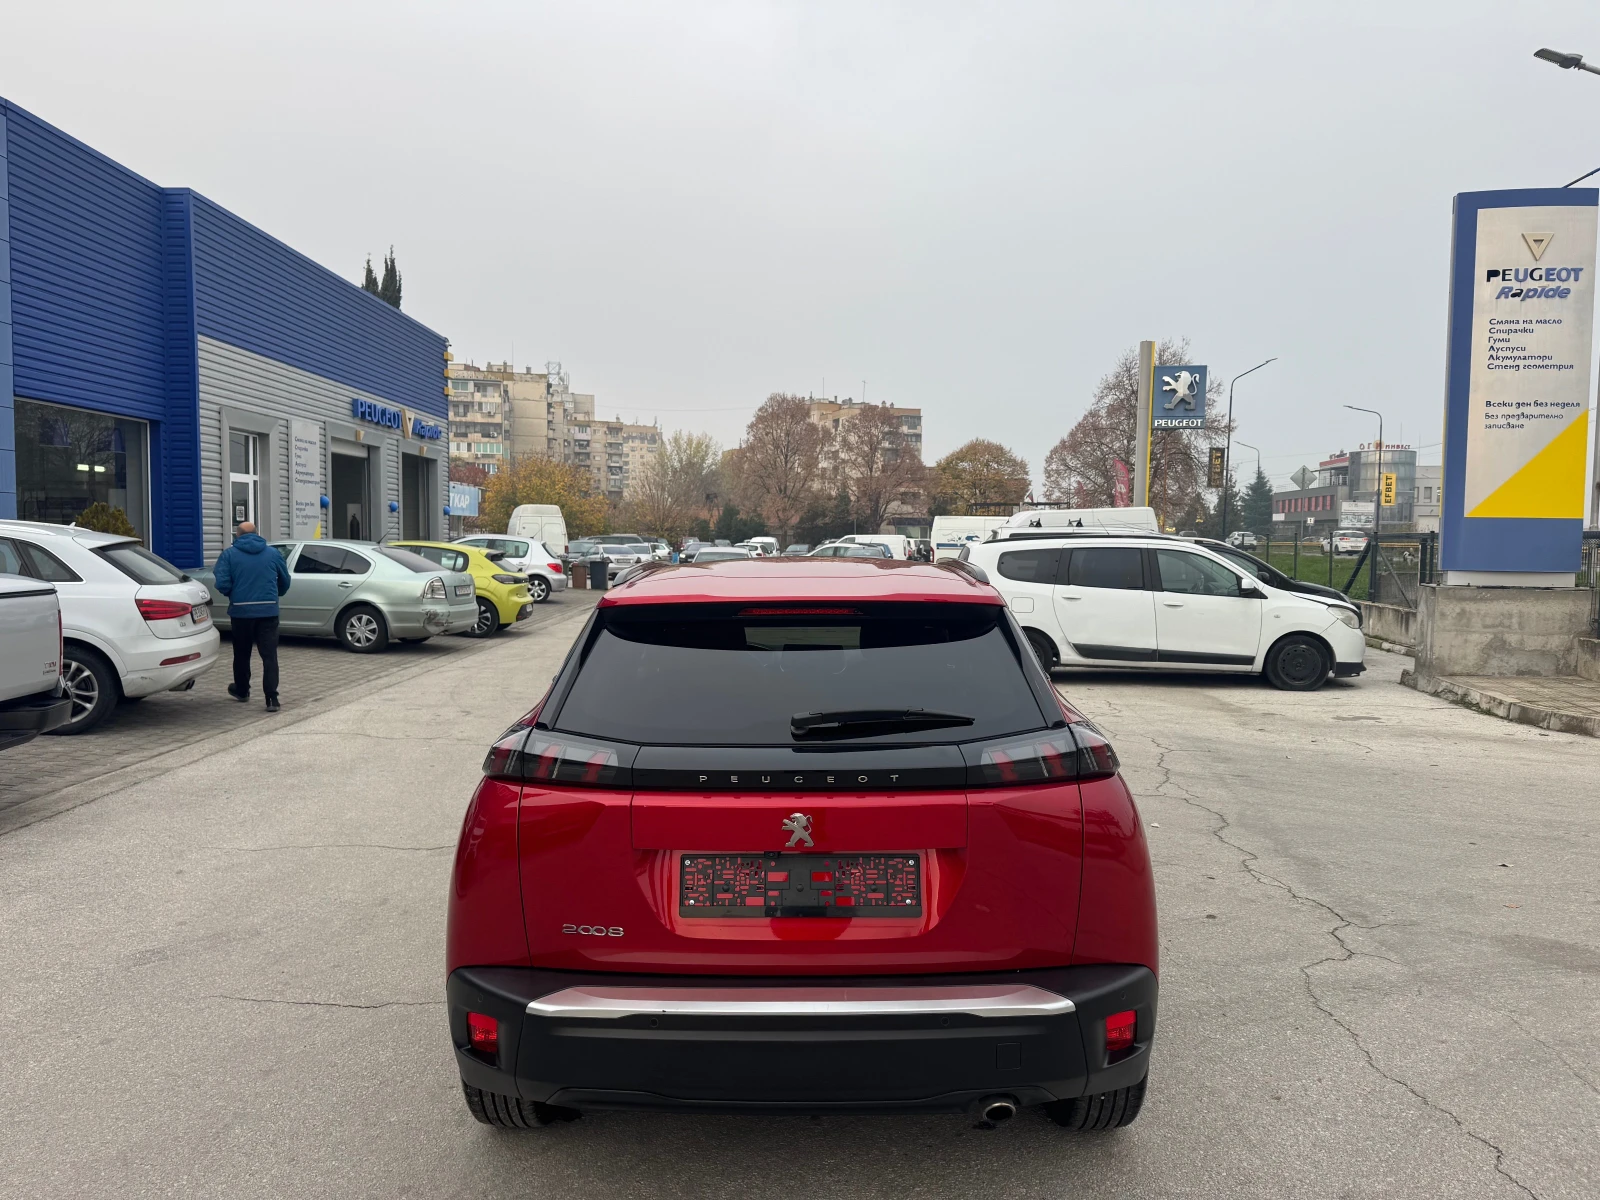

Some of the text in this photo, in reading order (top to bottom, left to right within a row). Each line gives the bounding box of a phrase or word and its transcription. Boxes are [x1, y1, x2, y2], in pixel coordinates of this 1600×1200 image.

[1486, 267, 1584, 282] PEUGEOT
[1495, 285, 1571, 301] Rapide
[1488, 327, 1534, 335] Спирачки
[1488, 336, 1511, 345] Гуми
[1488, 345, 1526, 353] Ауспуси
[1488, 354, 1553, 362] Акумулатори
[1487, 363, 1574, 371] Стенд геометрия
[1485, 399, 1580, 409] Всеки ден без неделя
[353, 398, 403, 430] PEUGEOT
[1484, 412, 1499, 420] Без
[1154, 418, 1203, 427] PEUGEOT
[1385, 475, 1393, 504] EFBET
[699, 774, 899, 783] PEUGEOT
[562, 923, 625, 937] 2008
